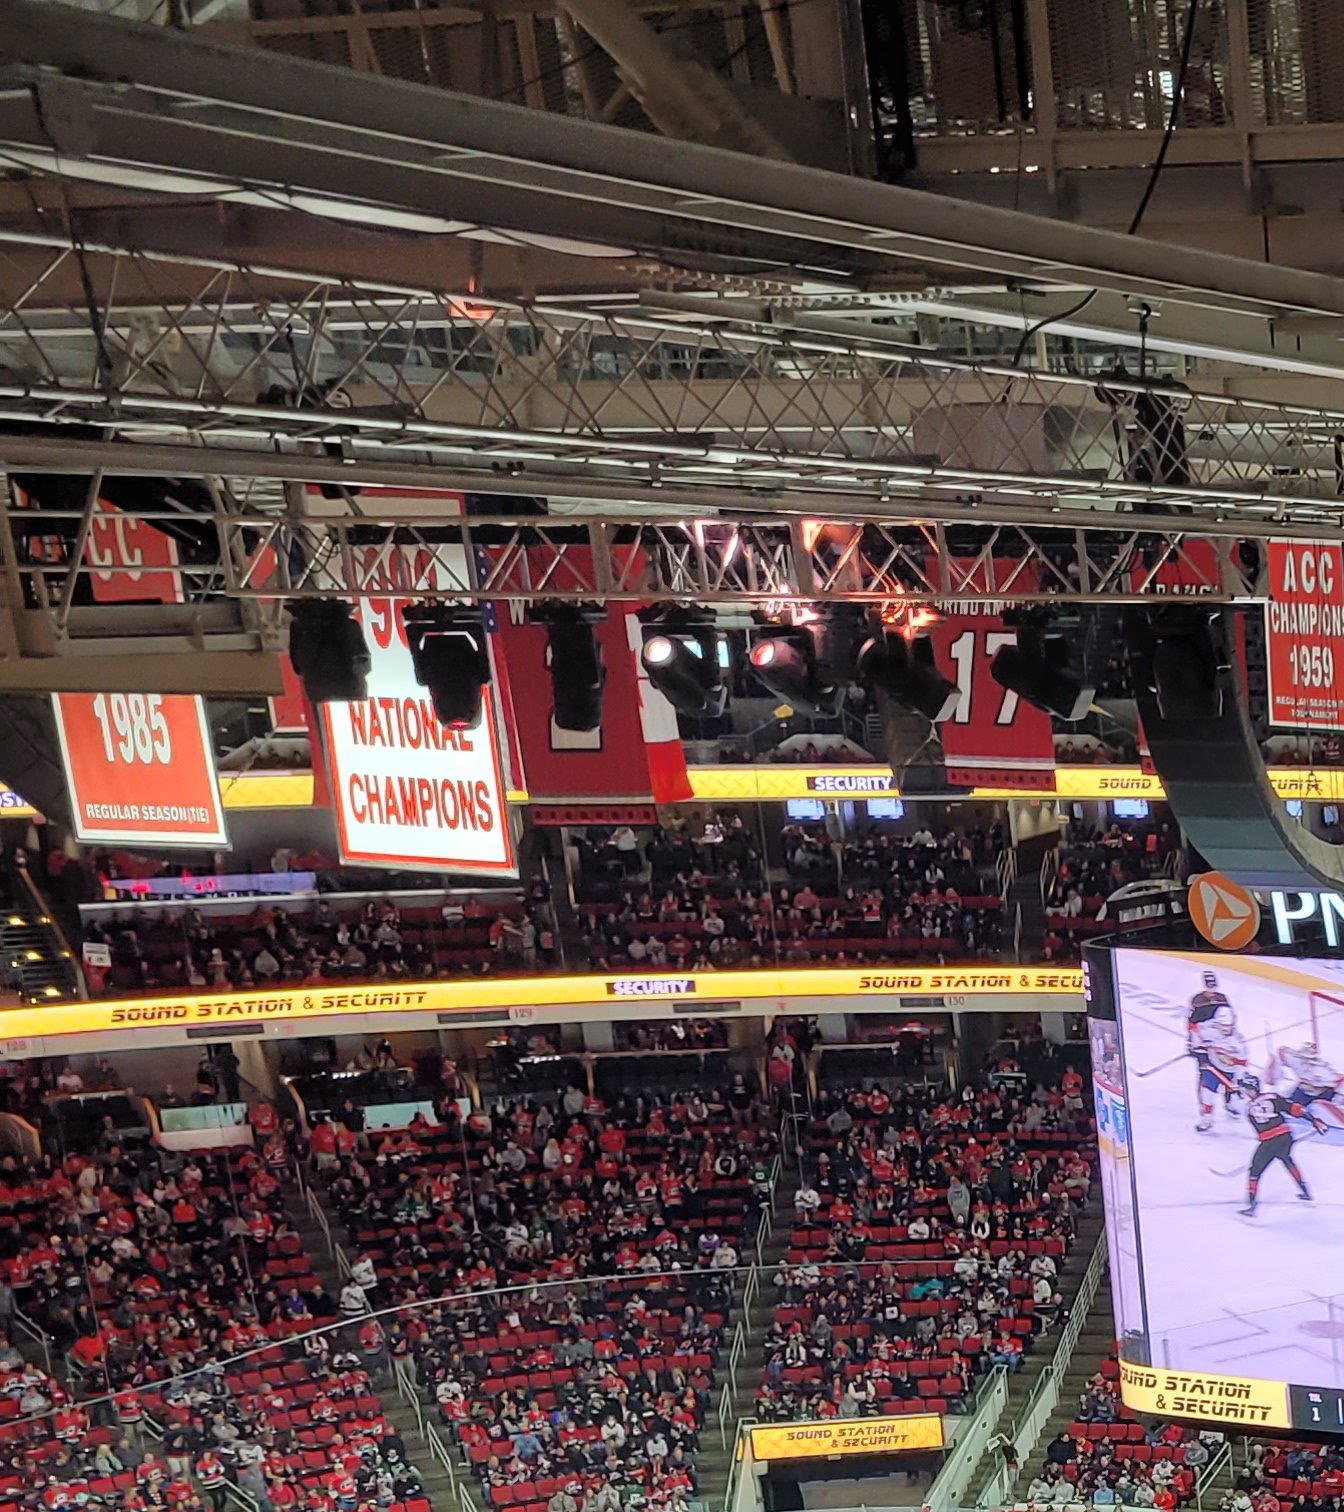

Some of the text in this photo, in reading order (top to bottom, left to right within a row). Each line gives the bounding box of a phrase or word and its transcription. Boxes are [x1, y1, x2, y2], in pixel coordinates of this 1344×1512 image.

[1283, 550, 1333, 593] ACC
[1290, 645, 1334, 688] 1959
[93, 691, 172, 765] 1985
[813, 776, 892, 791] SECURITY
[1099, 778, 1151, 789] SOUND
[86, 803, 187, 823] REGULAR SEASON
[350, 772, 494, 833] CHAMPIONS
[613, 980, 691, 995] SECURITY
[858, 976, 921, 989] SOUND
[930, 975, 1011, 988] STATION
[1019, 974, 1029, 987] &
[111, 991, 428, 1022] SOUND STATION & SECURITY
[1165, 1375, 1252, 1400] STATION
[1156, 1393, 1273, 1421] & SECURITY
[1312, 1406, 1321, 1422] 1
[786, 1424, 896, 1441] SOUND STATION
